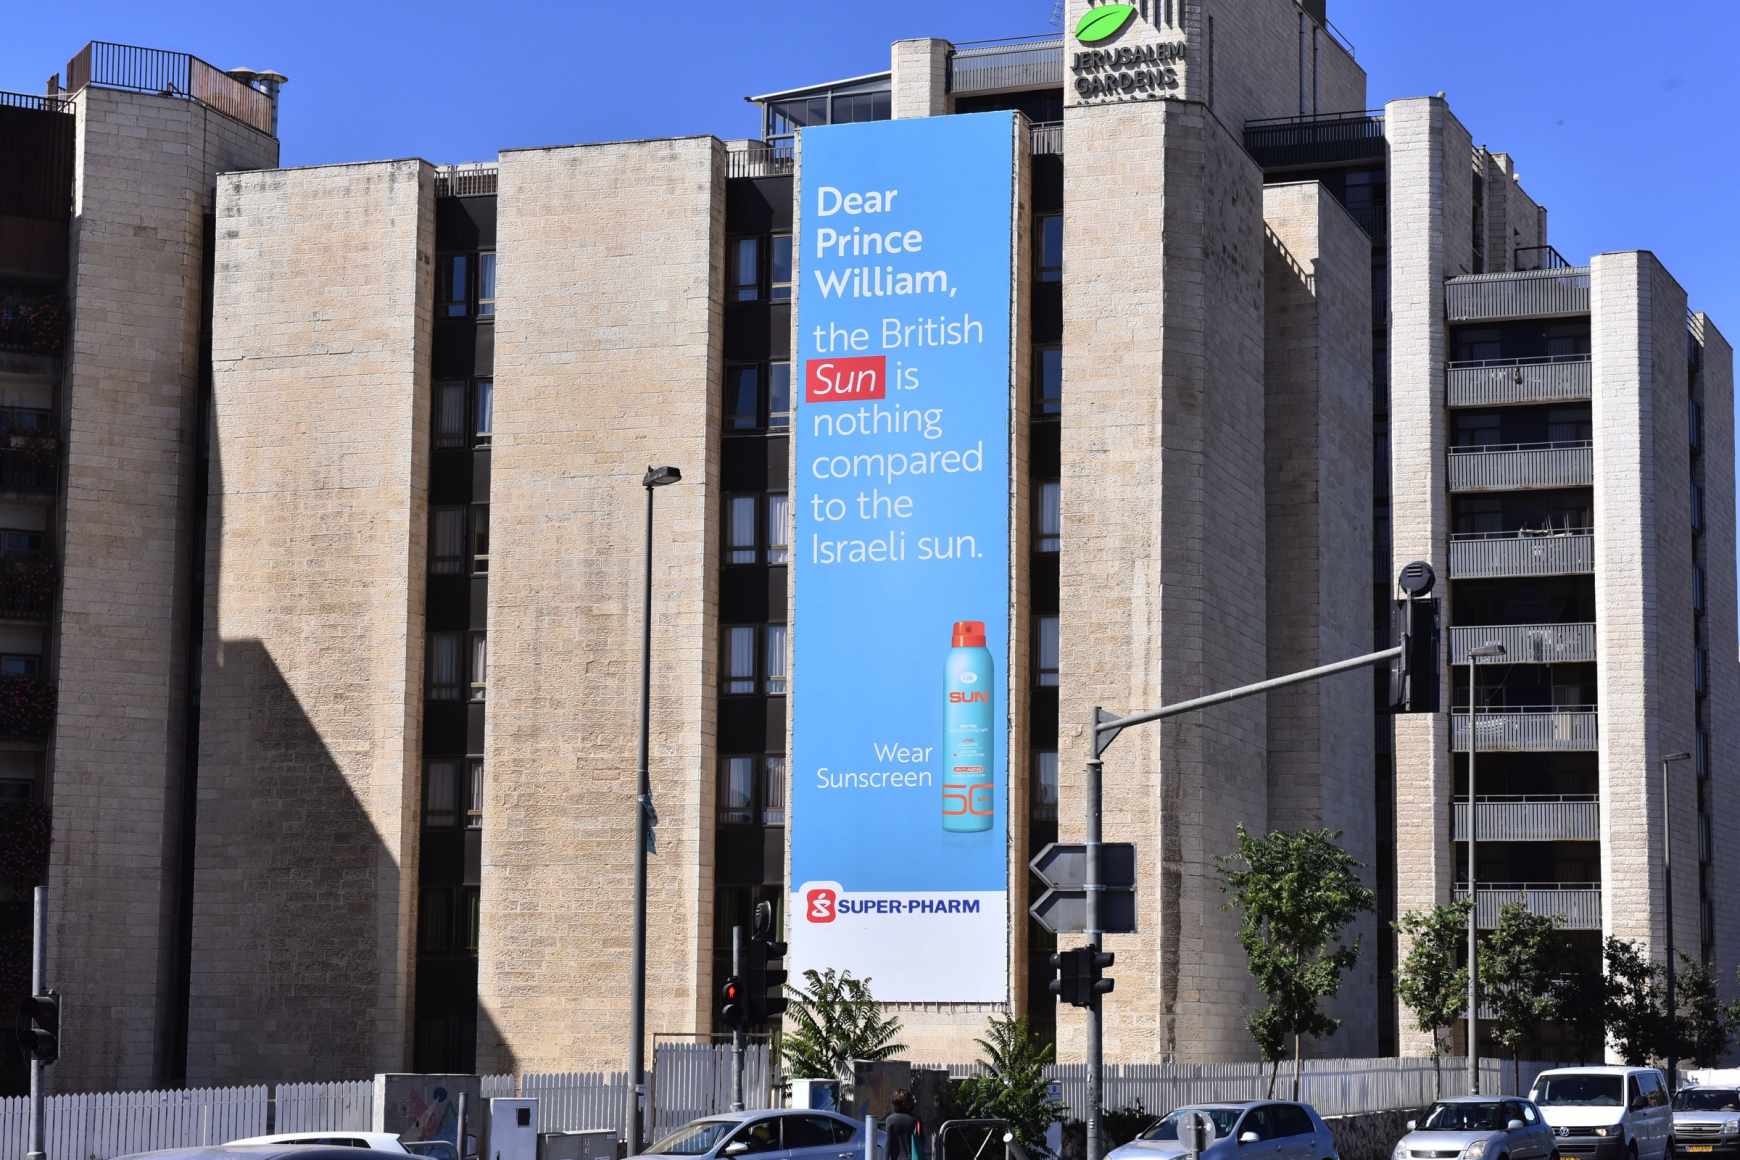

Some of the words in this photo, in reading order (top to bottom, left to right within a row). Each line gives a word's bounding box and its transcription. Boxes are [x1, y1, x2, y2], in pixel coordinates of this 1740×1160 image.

[1072, 41, 1185, 72] JERUSALEM
[1074, 67, 1178, 95] GARDENS
[817, 186, 898, 217] Dear
[816, 226, 923, 259] Prince
[814, 266, 958, 299] William,
[813, 322, 869, 353] the
[882, 313, 983, 349] British
[813, 363, 877, 395] Sun
[896, 361, 920, 390] is
[814, 403, 944, 440] nothing
[812, 440, 983, 485] compared
[810, 494, 846, 522] to
[856, 488, 913, 520] the
[812, 530, 905, 565] Israeli
[917, 535, 983, 560] sun.
[949, 690, 990, 705] SUN
[873, 742, 934, 763] Wear
[816, 767, 933, 789] Sunscreen
[838, 899, 981, 914] SUPER-PHARM
